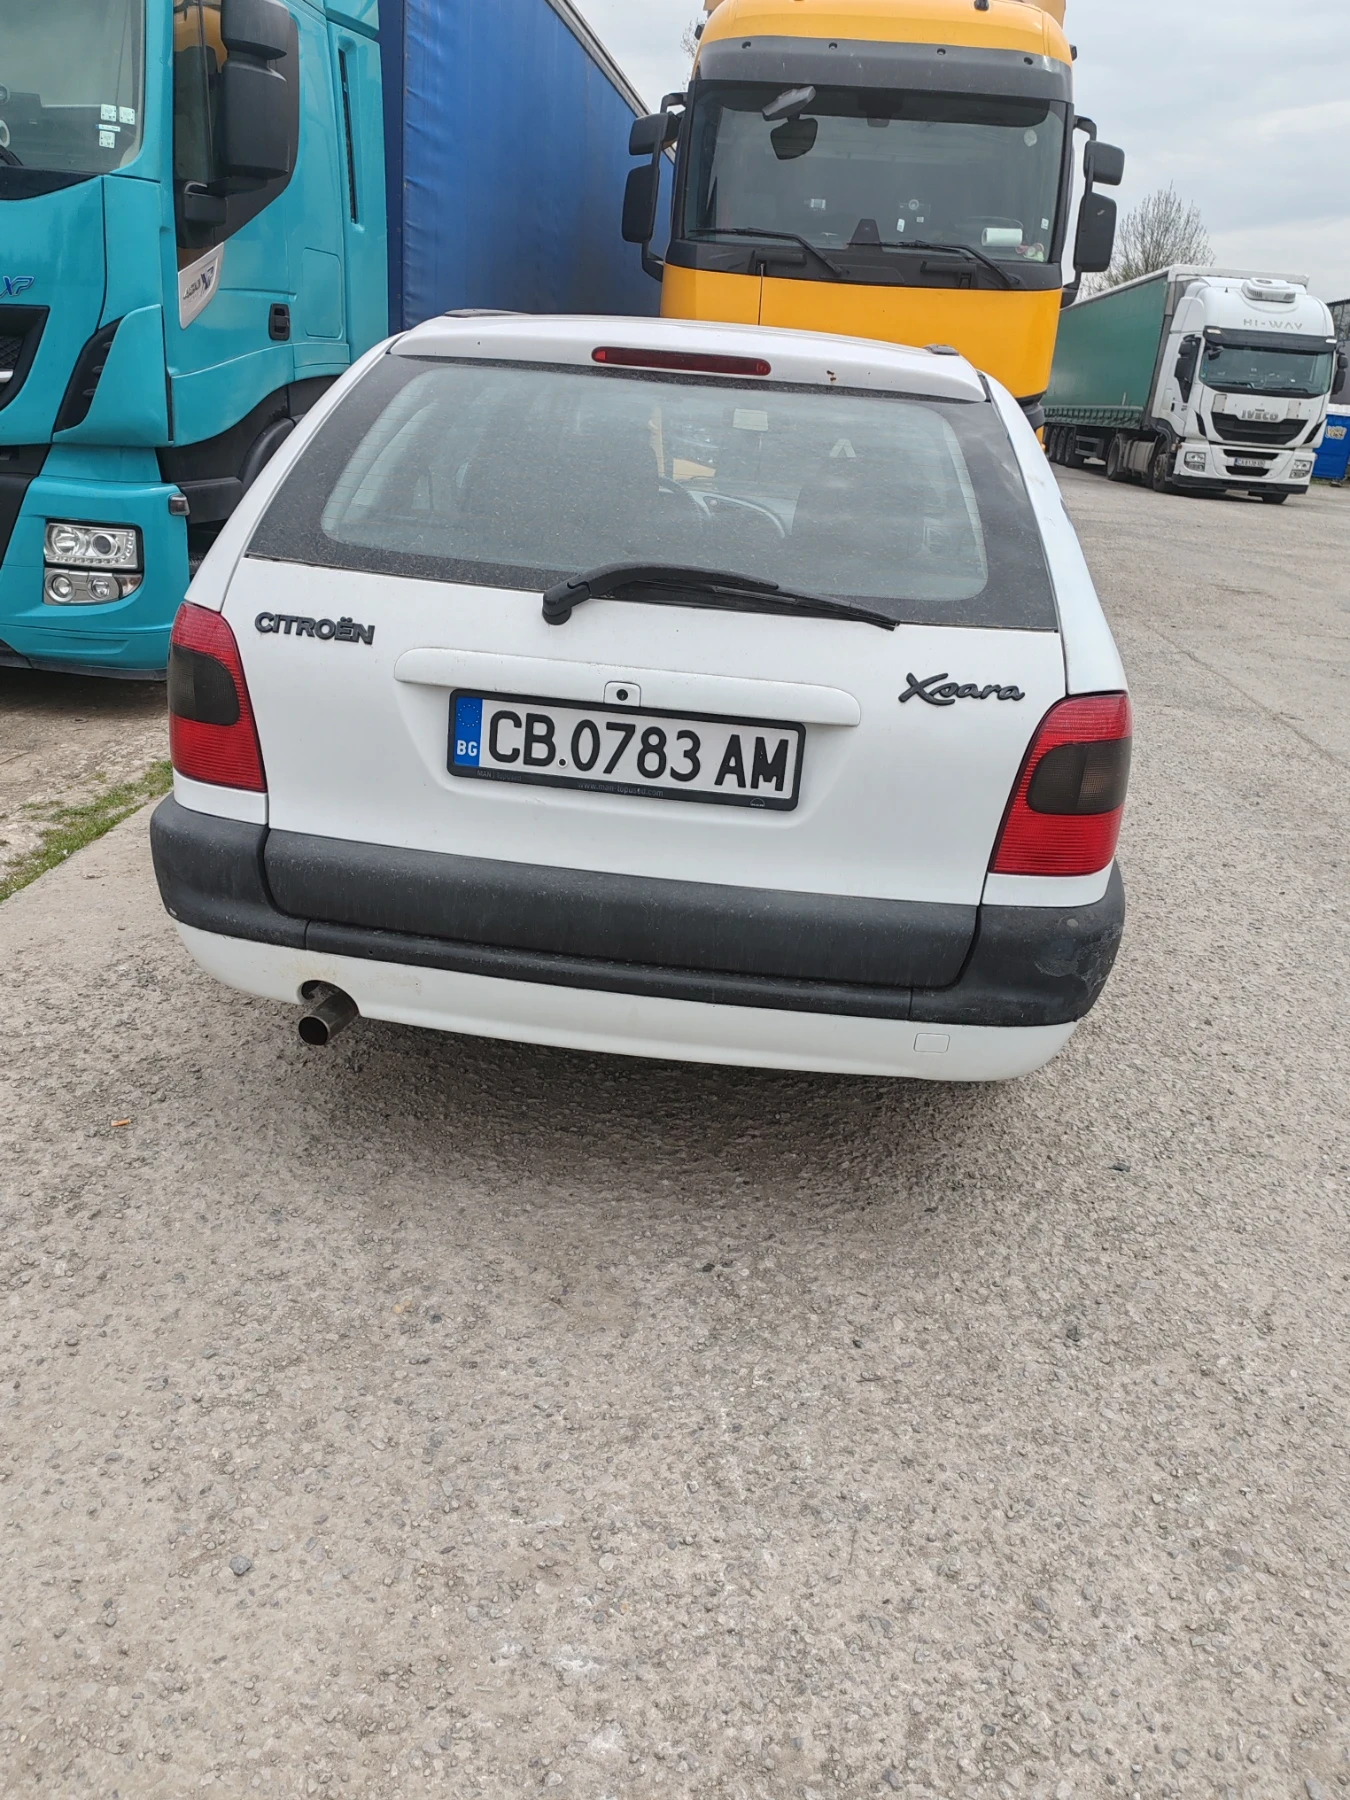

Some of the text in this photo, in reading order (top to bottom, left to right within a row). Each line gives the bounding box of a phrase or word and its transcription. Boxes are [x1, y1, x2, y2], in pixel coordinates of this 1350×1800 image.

[1241, 409, 1279, 421] IVECO
[254, 611, 376, 645] CITROËN
[898, 671, 1026, 706] Xsara
[456, 739, 478, 757] BG
[714, 733, 789, 792] AM
[476, 769, 492, 778] MAN
[577, 780, 664, 798] www.man-topused.com
